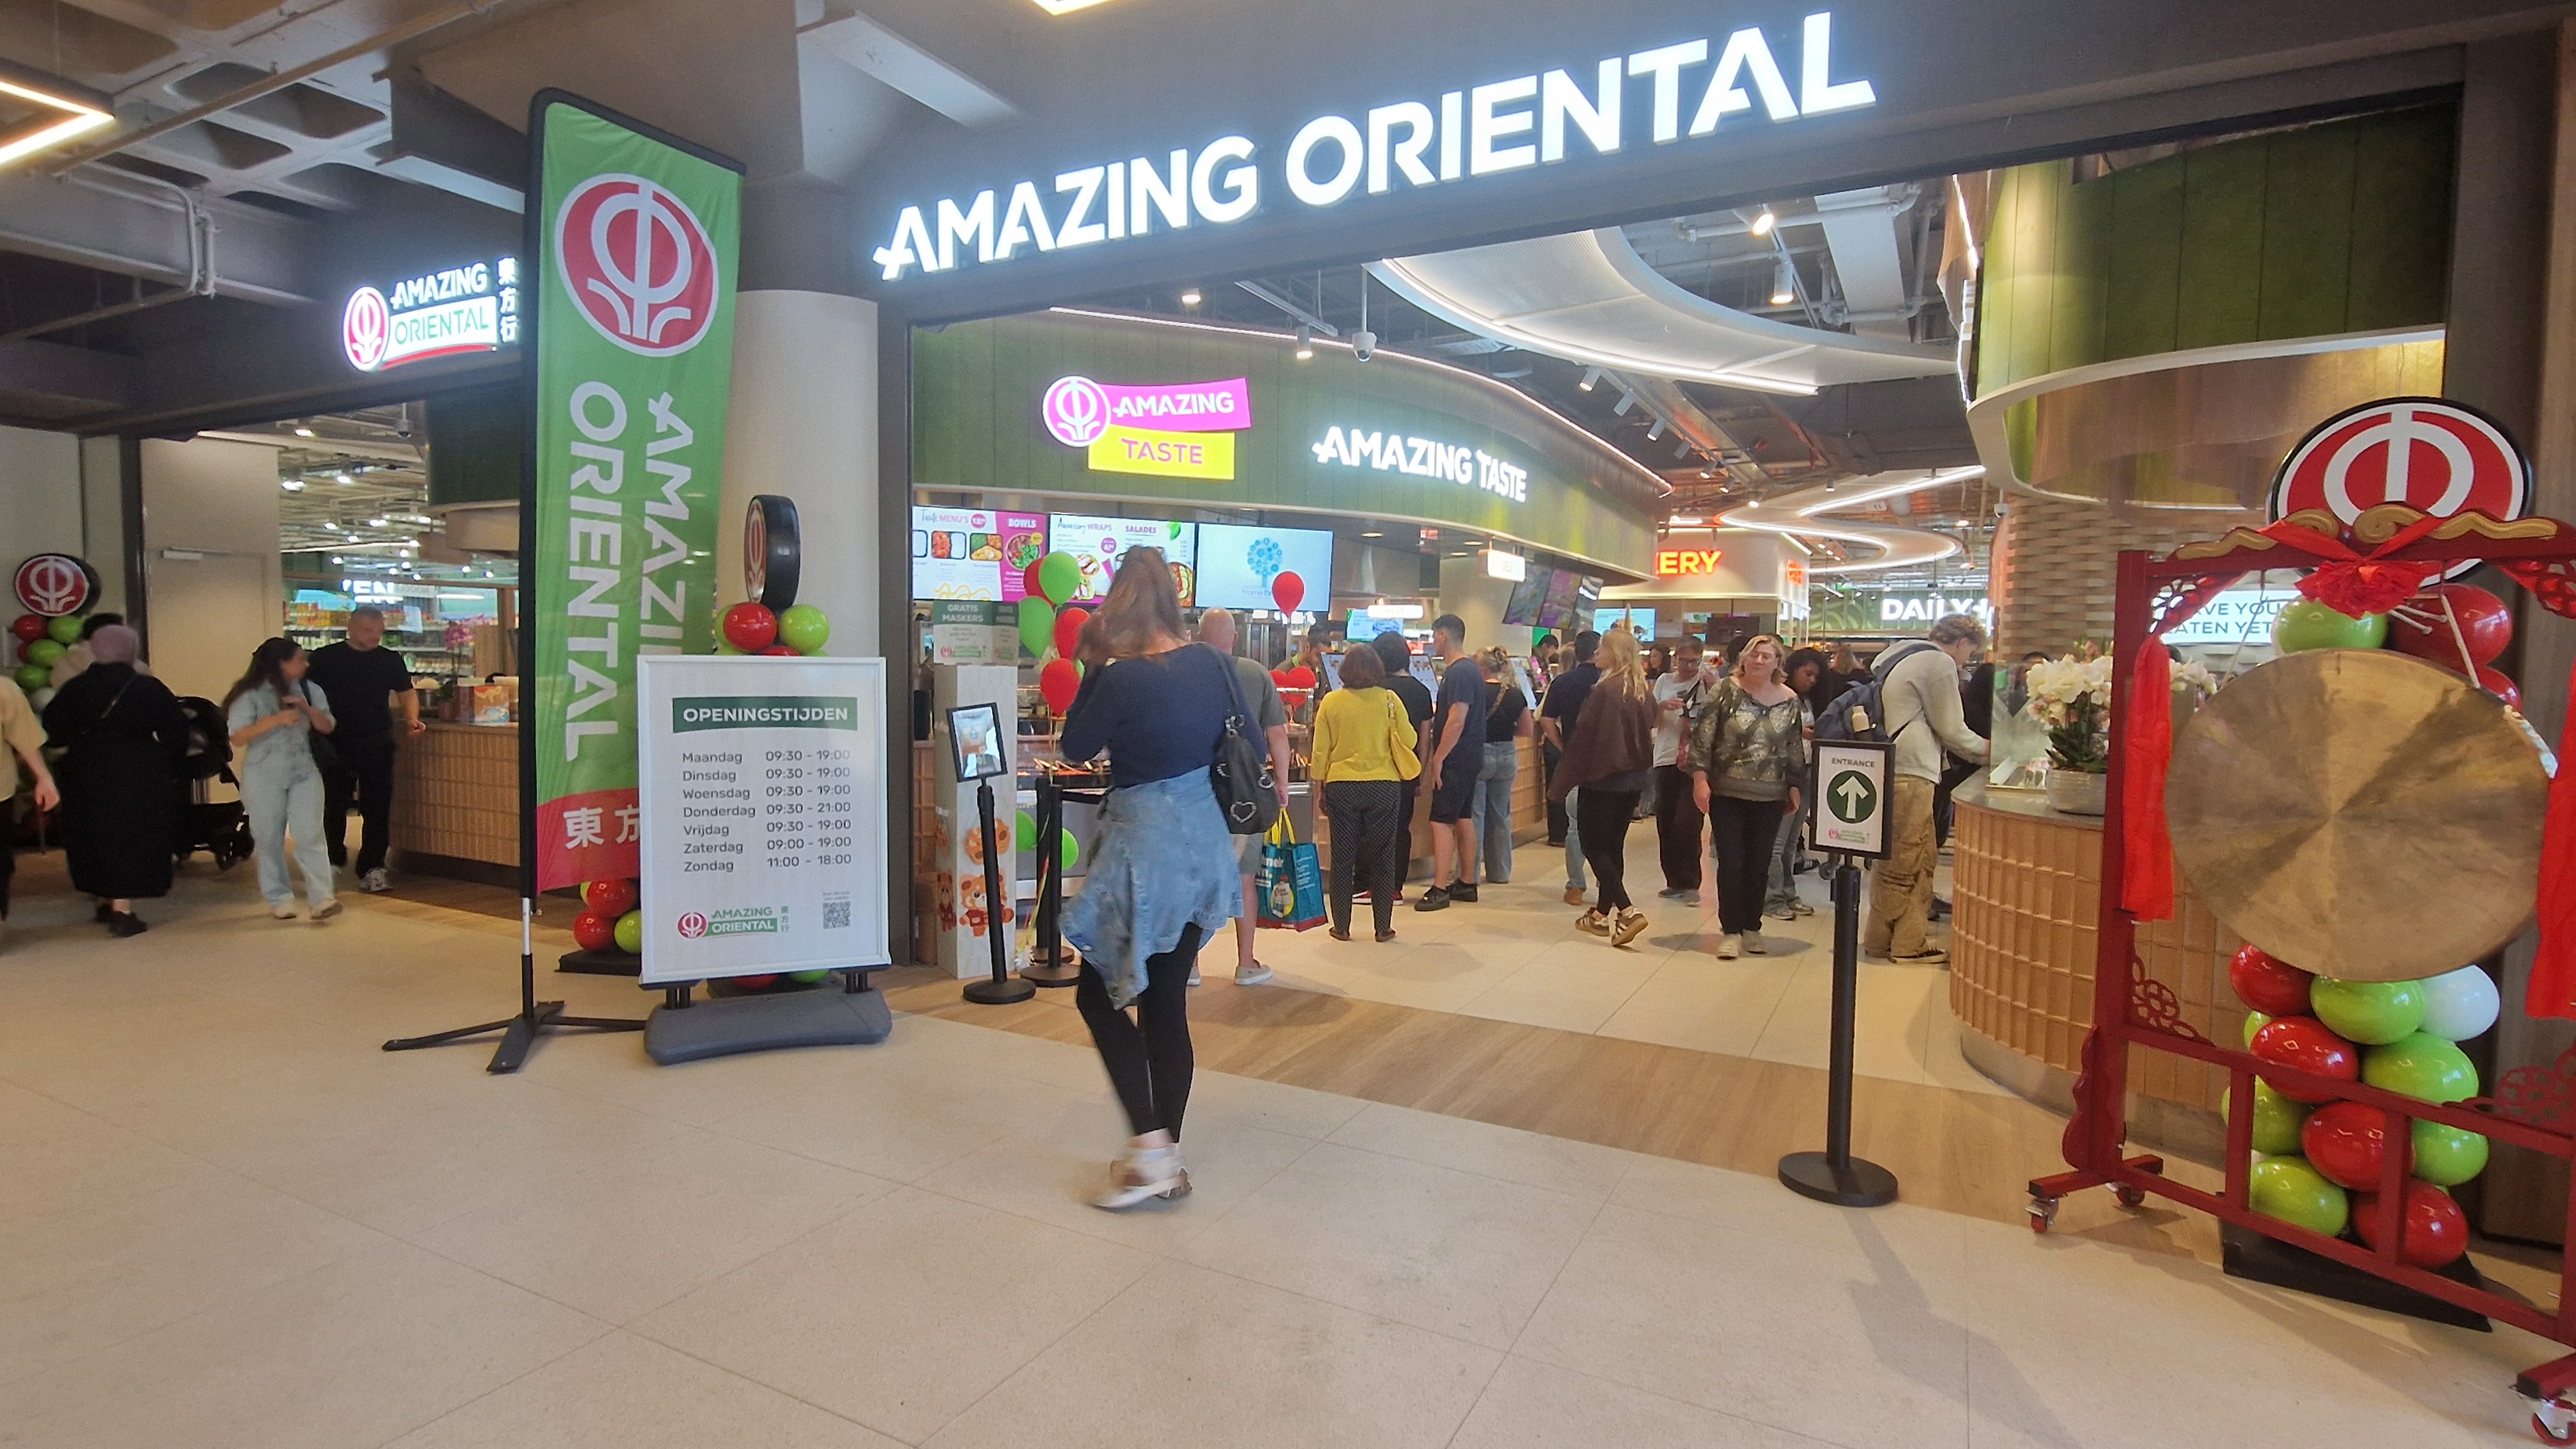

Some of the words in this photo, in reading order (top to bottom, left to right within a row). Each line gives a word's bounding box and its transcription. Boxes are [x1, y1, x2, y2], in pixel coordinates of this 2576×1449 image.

[871, 135, 1259, 281] AMAZING
[1285, 11, 1876, 206] ORIENTAL
[390, 262, 488, 310] AMAZING
[498, 256, 518, 343] 東方行
[395, 306, 489, 345] ORIENTAL
[1113, 391, 1235, 418] AMAZING
[1120, 438, 1204, 464] TASTE
[1311, 426, 1473, 485] AMAZING
[1476, 448, 1528, 503] TASTE
[640, 390, 694, 656] AMAZI
[939, 514, 969, 524] MENU'S
[1008, 517, 1037, 528] BOWLS
[1087, 523, 1112, 532] WRAPS
[1125, 525, 1157, 534] SALADES
[1655, 550, 1723, 575] ERY
[564, 380, 627, 763] ORIENTAL
[1881, 597, 1974, 621] DAILY
[2235, 602, 2280, 616] YOU
[942, 614, 984, 623] MASKERS
[2170, 621, 2229, 634] ATEN
[682, 707, 848, 723] OPENINGSTIJDEN
[683, 752, 743, 764] Maandag
[766, 750, 802, 761] 09:30
[816, 750, 850, 761] 19:00
[1831, 757, 1876, 768] ENTRANCE
[683, 770, 736, 783] Dinsdag
[766, 768, 803, 779] 09:30
[817, 768, 851, 778] 19:00
[683, 788, 750, 801] Woensdag
[766, 786, 803, 797] 09:30
[817, 785, 851, 795] 19:00
[683, 805, 756, 818] Donderdag
[767, 804, 803, 815] 09:30
[817, 802, 851, 813] 21:00
[683, 824, 729, 837] Vrijdag
[767, 821, 804, 832] 09:30
[818, 819, 851, 830] 19:00
[684, 842, 743, 855] Zaterdag
[767, 839, 804, 850] 09:00
[818, 837, 852, 848] 19:00
[684, 860, 734, 873] Zondag
[767, 856, 799, 867] 11:00
[817, 854, 852, 865] 18:00
[711, 906, 772, 919] AMAZING
[712, 920, 775, 934] ORIENTAL
